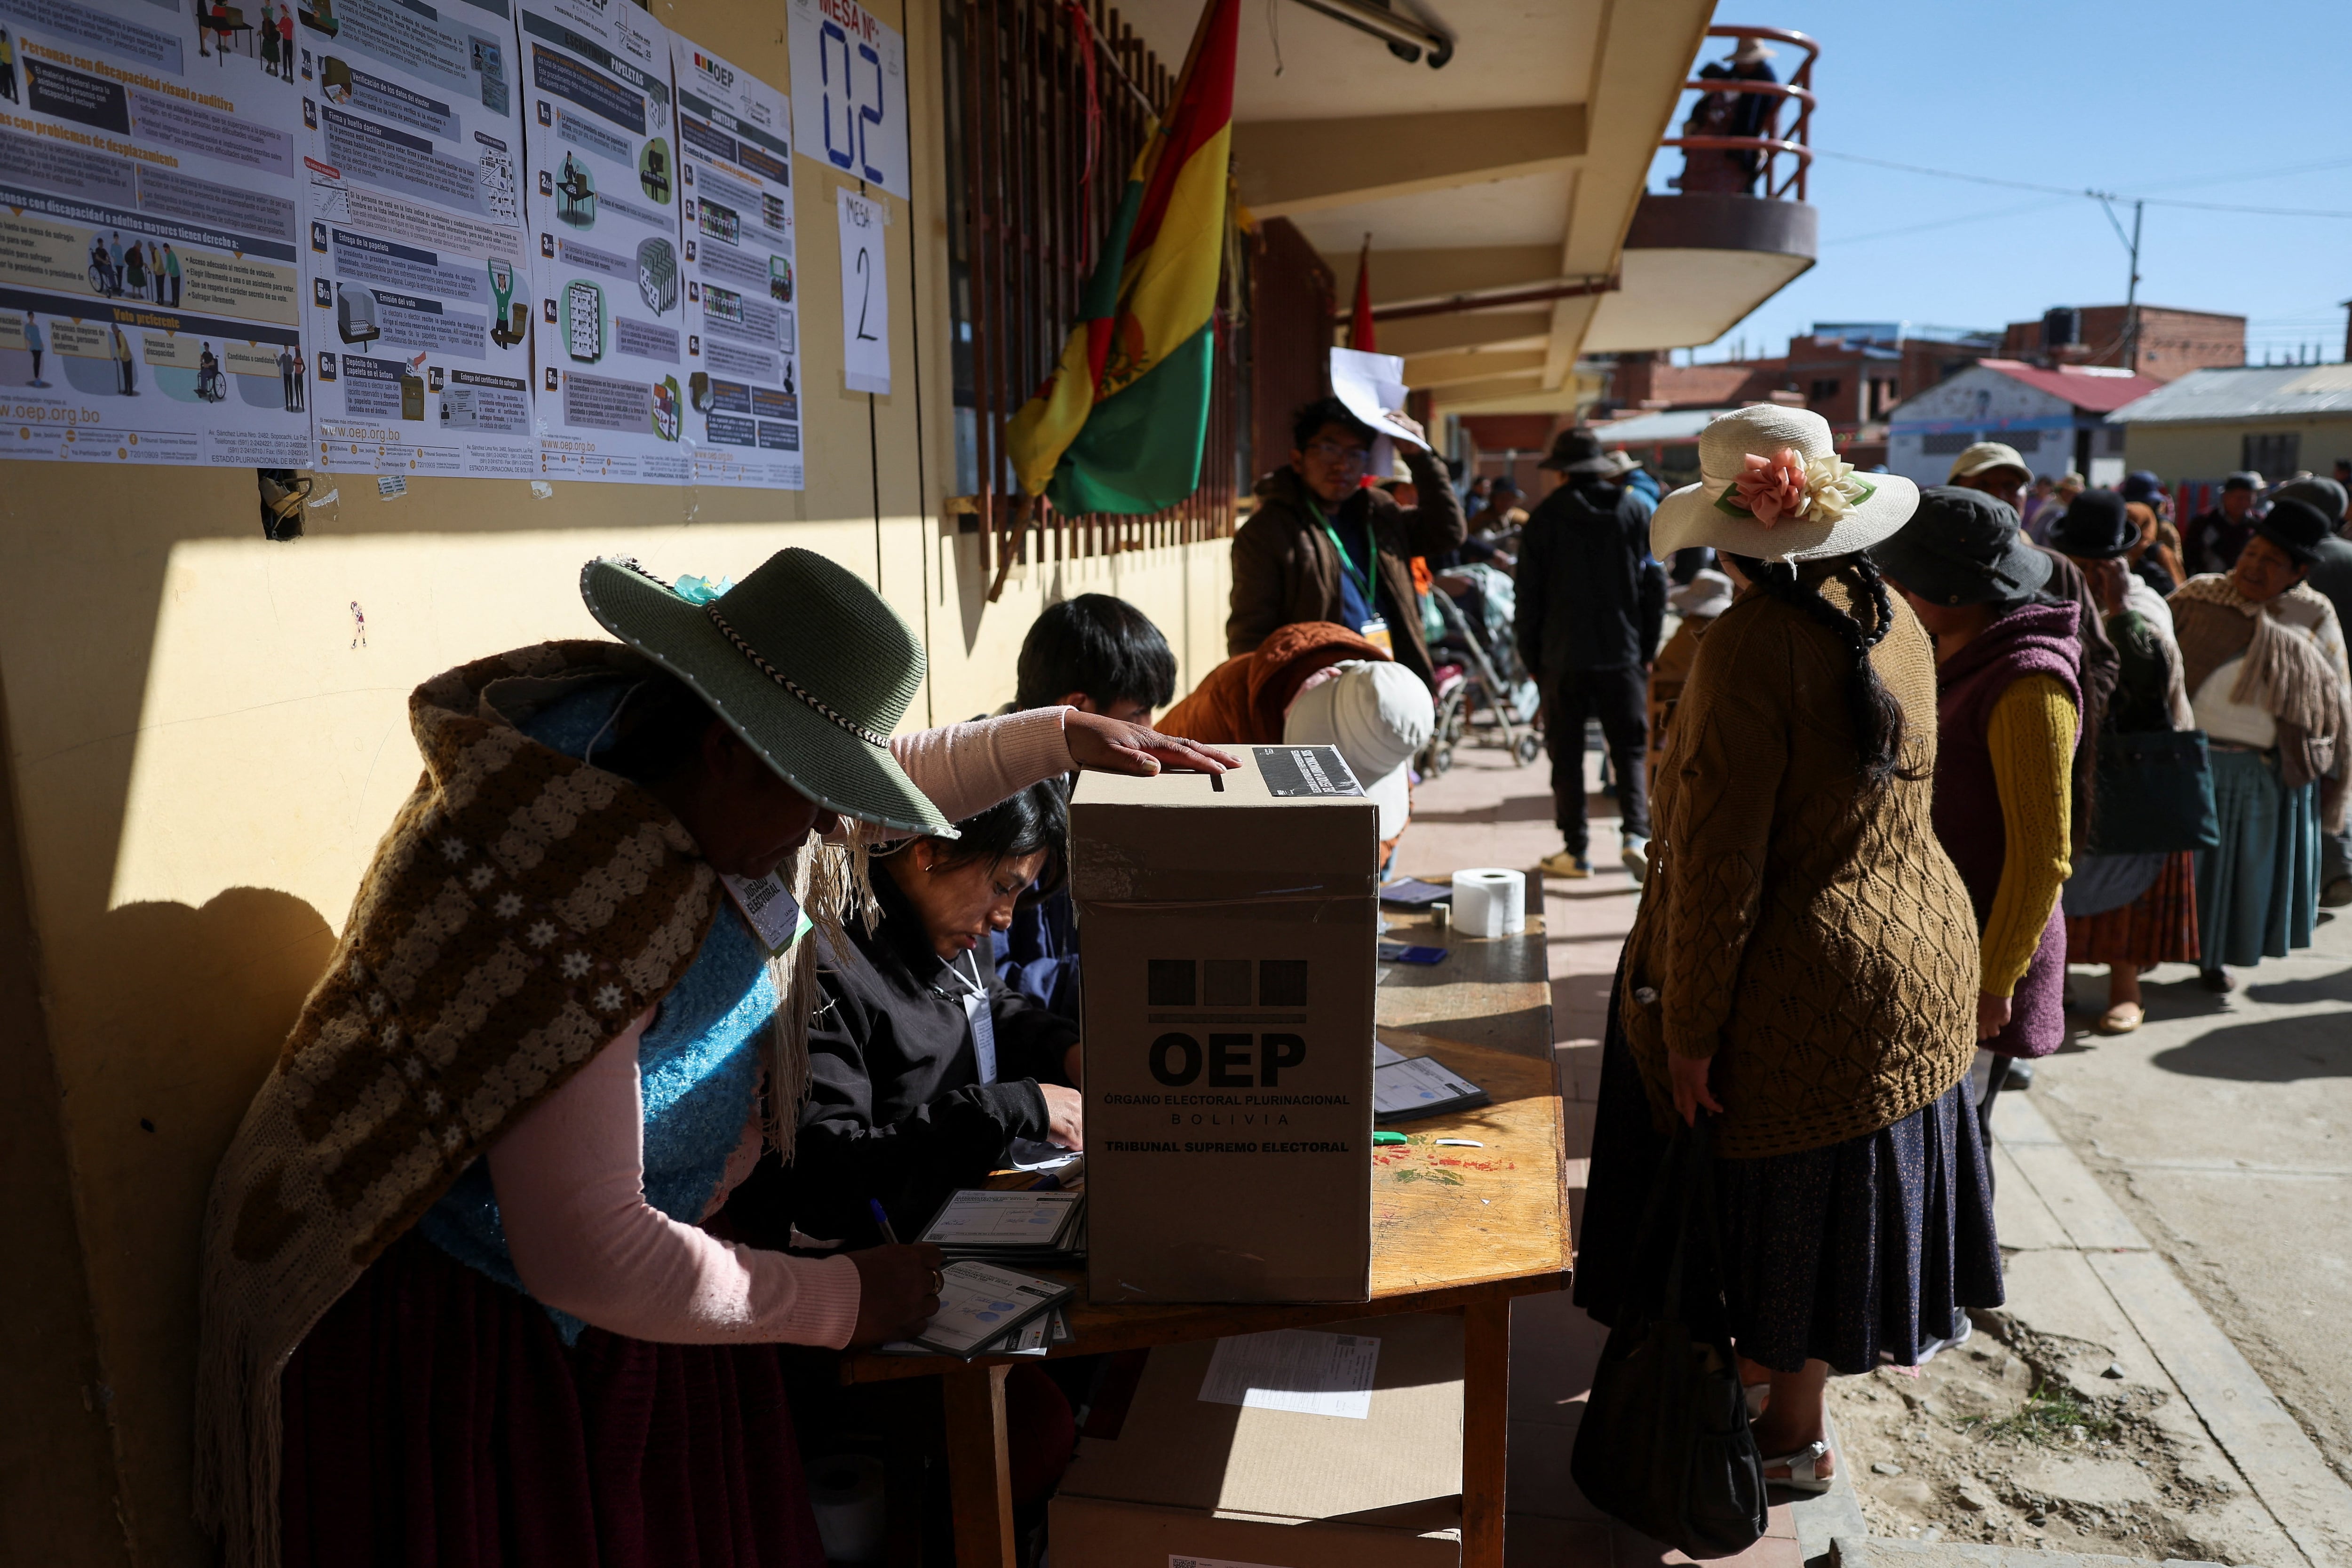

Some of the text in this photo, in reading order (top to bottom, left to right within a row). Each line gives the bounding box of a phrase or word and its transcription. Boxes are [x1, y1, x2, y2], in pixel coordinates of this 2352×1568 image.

[554, 6, 608, 37] TRIBUNAL SUPREMO ELECTORAL
[20, 38, 234, 112] Personas con discapacidad visual o auditiva
[611, 57, 644, 86] PAPELETAS
[714, 64, 734, 88] OEP
[352, 73, 379, 88] Verificación
[381, 82, 386, 91] de
[396, 88, 407, 99] datos
[415, 96, 429, 108] elector
[820, 20, 884, 184] 02
[305, 102, 315, 121] 3ro
[540, 104, 549, 119] 1ro
[329, 112, 342, 122] Firma
[348, 118, 362, 129] huella
[364, 123, 382, 135] dactilar
[14, 118, 178, 168] con problemas de desplazamiento
[542, 174, 551, 189] 2do
[29, 199, 45, 209] con
[47, 200, 104, 221] discapacidad
[106, 214, 111, 223] o
[113, 214, 143, 229] adultos
[144, 223, 177, 236] mayores
[179, 227, 201, 241] tienen
[203, 232, 230, 247] derecho
[314, 227, 325, 244] 4to
[339, 233, 355, 244] Entrega
[369, 242, 388, 251] papeleta
[544, 237, 552, 251] 3ro
[190, 257, 206, 266] Acceso
[207, 261, 227, 270] adecuado
[256, 270, 276, 278] votación.
[190, 269, 203, 278] Elegir
[205, 271, 228, 281] libremente
[253, 280, 271, 288] asistente
[192, 292, 236, 305] Sufragar libremente.
[317, 283, 330, 299] 5to
[380, 294, 397, 303] Emisión
[857, 246, 878, 340] 2
[547, 303, 555, 316] 4to
[113, 309, 180, 328] Voto preferente
[145, 339, 165, 347] Personas
[146, 348, 175, 357] discapacidad
[228, 353, 250, 361] Candidatas
[321, 356, 334, 372] 6to
[346, 358, 366, 367] Depósito
[430, 370, 443, 385] 7mo
[461, 373, 474, 382] Entrega
[504, 379, 517, 387] sufragio
[548, 371, 556, 384] 5to
[541, 440, 595, 453] www.oep.org.bo
[746, 882, 780, 915] ELECTORAL
[1149, 1032, 1306, 1087] OEP
[1104, 1093, 1350, 1105] ÓRGANO ELECTORAL PLURINACIONAL
[1172, 1114, 1288, 1125] BOLIVIA
[1105, 1141, 1349, 1152] TRIBUNAL SUPREMO ELECTORAL
